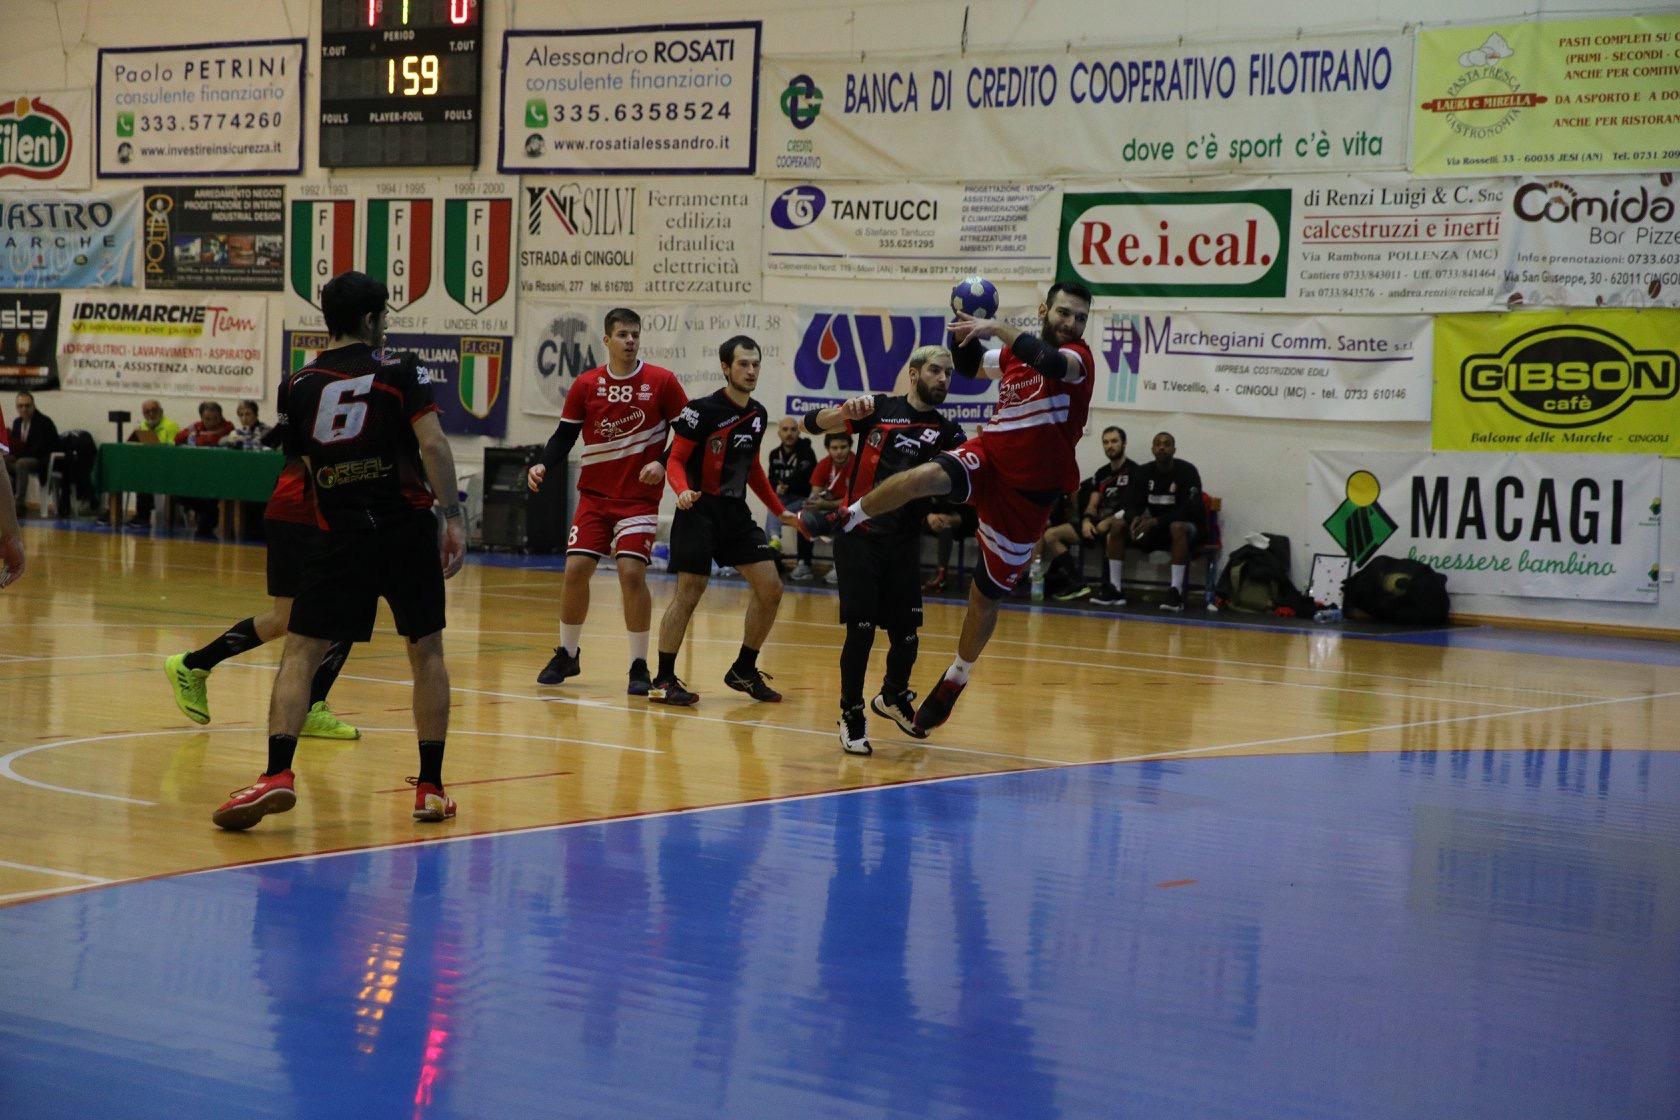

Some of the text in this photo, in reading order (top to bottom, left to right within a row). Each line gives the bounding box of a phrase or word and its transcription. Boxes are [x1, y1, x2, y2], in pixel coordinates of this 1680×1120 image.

[383, 31, 415, 41] PERIOD
[1559, 36, 1592, 48] PASTI
[1594, 33, 1653, 46] COMPLETI
[322, 46, 346, 57] T.OUT
[449, 40, 475, 51] T.OUT
[526, 39, 735, 66] Alessandro ROSATI
[1612, 49, 1664, 62] SECONDI
[115, 57, 286, 83] Paolo PETRINI
[1564, 69, 1602, 80] ANCHE
[1606, 68, 1630, 78] PER
[526, 67, 732, 91] consulente finanziario
[844, 46, 1392, 114] BANCA DI CREDITO COOPERATIVO FILOTTRANO
[115, 82, 284, 105] consulente finanziario
[1554, 92, 1631, 105] DA ASPORTO
[1436, 95, 1532, 111] LAURA MIRELLA
[322, 113, 349, 124] FOULS
[369, 111, 424, 123] PLAYER-FOUL
[444, 109, 473, 121] FOULS
[554, 101, 731, 122] 335.6358524
[140, 112, 282, 132] 333.5774260
[1445, 108, 1522, 140] GASTRONOMIA
[1553, 115, 1618, 127] ANCHE PER
[0, 121, 57, 164] ileni
[141, 141, 281, 157] www.investireinsicurezza.it
[554, 136, 730, 151] www.rosatialessandro.it
[787, 139, 813, 153] CREDITO
[1122, 138, 1174, 162] dove
[1229, 132, 1283, 163] sport
[1342, 129, 1383, 157] vita
[776, 155, 822, 168] COOPERATIVO
[1447, 157, 1460, 167] Via
[1558, 153, 1580, 163] JESI
[1581, 152, 1604, 163] (AN)
[1612, 151, 1629, 161] Tel.
[299, 185, 320, 196] 1992
[376, 183, 426, 194] 1994 1995
[454, 182, 506, 194] 1999 2000
[648, 190, 749, 207] Ferramenta
[1304, 189, 1320, 207] di
[1327, 188, 1375, 206] Renzi
[1381, 187, 1426, 209] Luigi
[1432, 187, 1447, 205] &
[1454, 185, 1474, 205] C.
[1513, 182, 1676, 223] Comida
[832, 200, 938, 221] TANTUCCI
[665, 212, 732, 229] edilizia
[1303, 216, 1500, 239] calcestruzzi e inerti
[866, 228, 936, 238] Stefano Tantucci
[1589, 227, 1625, 245] Bar
[658, 235, 735, 251] idraulica
[1078, 219, 1271, 267] Re.i.cal.
[521, 250, 635, 266] STRADA di CINGOLI
[1302, 248, 1499, 262] Via Rambona POLLENZA (MC)
[1517, 252, 1540, 262] Info
[1550, 254, 1625, 267] prenotazioni:
[653, 257, 739, 274] elettricità
[1300, 269, 1341, 280] Cantiere
[1504, 270, 1520, 284] Via
[1522, 270, 1540, 284] San
[1589, 272, 1602, 285] 30
[1610, 272, 1641, 285] 62011
[521, 281, 535, 292] Via
[569, 281, 583, 292] 277
[590, 280, 603, 292] tel.
[645, 281, 752, 294] attrezzature
[1299, 287, 1316, 298] Fax
[73, 303, 207, 323] IDROMARCHE
[206, 306, 256, 337] Team
[445, 318, 480, 330] UNDER
[1145, 316, 1265, 355] Marchegiani
[1271, 333, 1332, 351] Comm.
[1337, 335, 1388, 352] Sante
[208, 348, 261, 361] ASPIRATORI
[537, 339, 598, 378] CNA
[73, 358, 254, 376] VENDITA ASSISTENZA NOLEGGIO
[1215, 364, 1250, 375] IMPRESA
[1471, 361, 1672, 392] GIBSON
[608, 385, 634, 403] 88
[1143, 380, 1157, 391] Via
[1213, 383, 1221, 393] 4
[1235, 384, 1279, 397] CINGOLI
[1283, 386, 1308, 399] (MC)
[1321, 388, 1338, 400] tel.
[1344, 388, 1369, 400] 0733
[1372, 388, 1407, 400] 610146
[313, 373, 376, 445] 6
[1543, 394, 1593, 411] cafè
[751, 416, 762, 433] 4
[1471, 431, 1671, 443] Balcone delle Marche CINGOLI
[1410, 475, 1624, 545] MACAGI
[1407, 546, 1617, 577] benessere bambino
